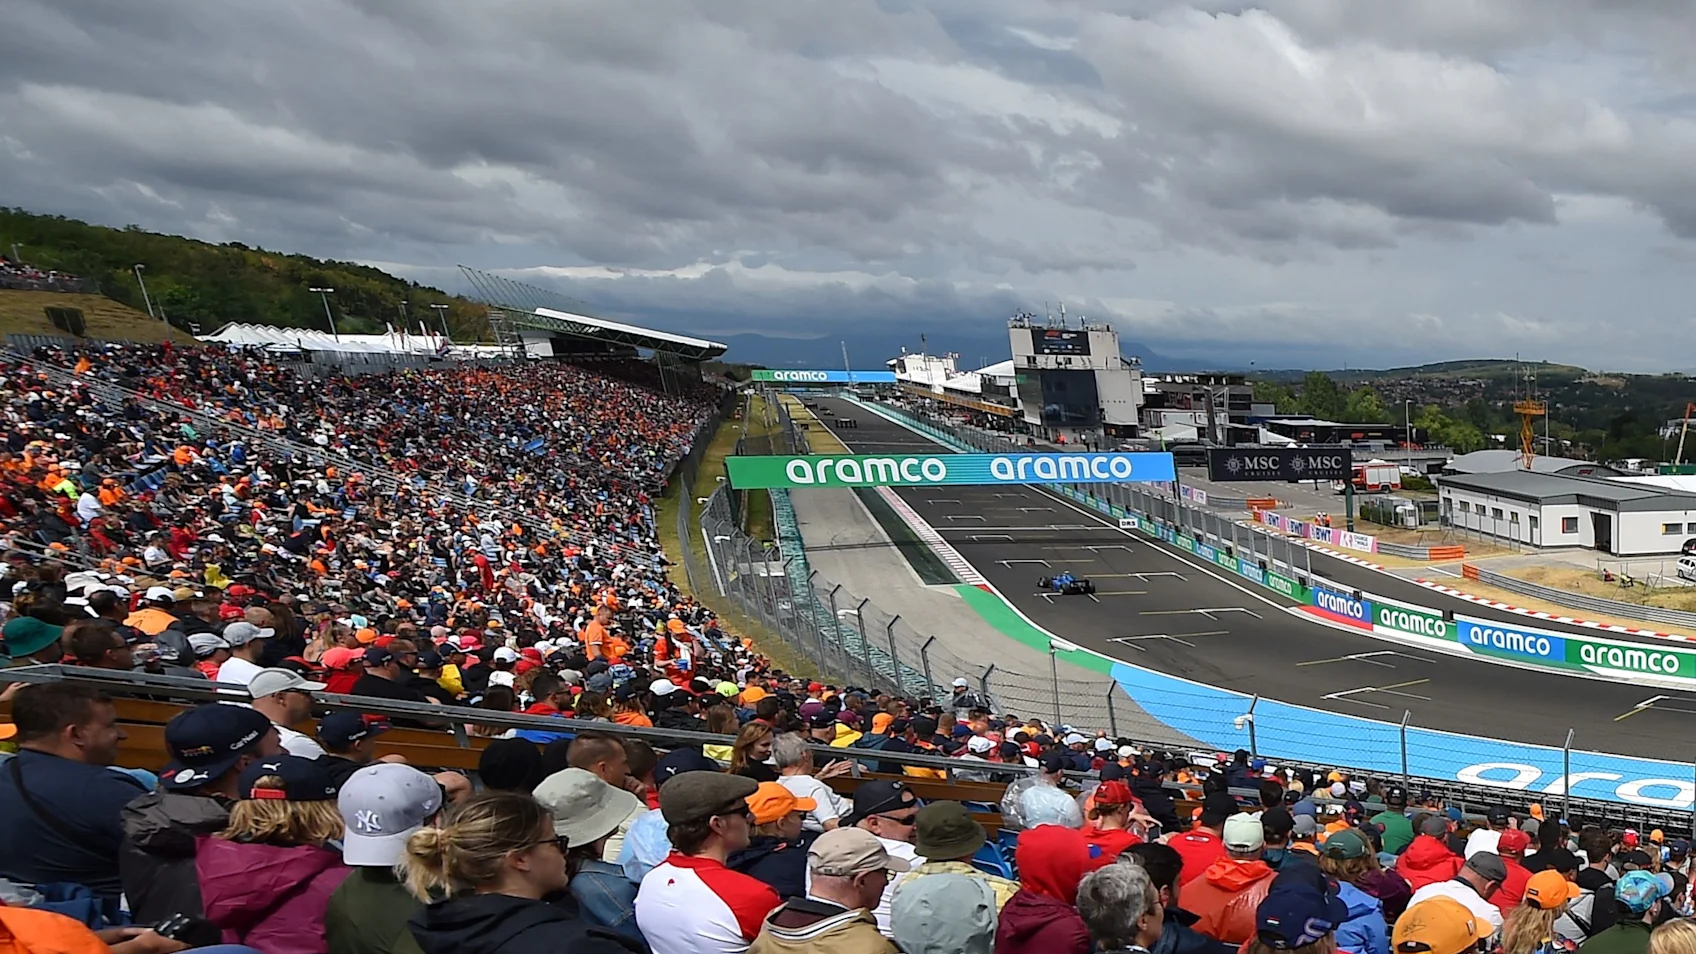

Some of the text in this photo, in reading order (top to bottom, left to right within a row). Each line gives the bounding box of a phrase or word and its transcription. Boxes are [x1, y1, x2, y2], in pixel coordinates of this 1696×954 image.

[774, 370, 828, 381] aramco
[785, 457, 946, 484] aramco
[990, 452, 1132, 480] aramco
[1244, 456, 1280, 470] MSC
[1308, 456, 1342, 469] MSC
[1268, 512, 1280, 529] BWT
[1290, 518, 1304, 536] BWT
[1315, 526, 1332, 543] BWT
[1242, 564, 1263, 582] aramco
[1268, 575, 1292, 594] aramco
[1317, 590, 1364, 619] aramco
[1379, 607, 1446, 637] aramco
[1469, 624, 1551, 656] aramco
[1580, 642, 1680, 674] aramco
[355, 810, 382, 832] NY
